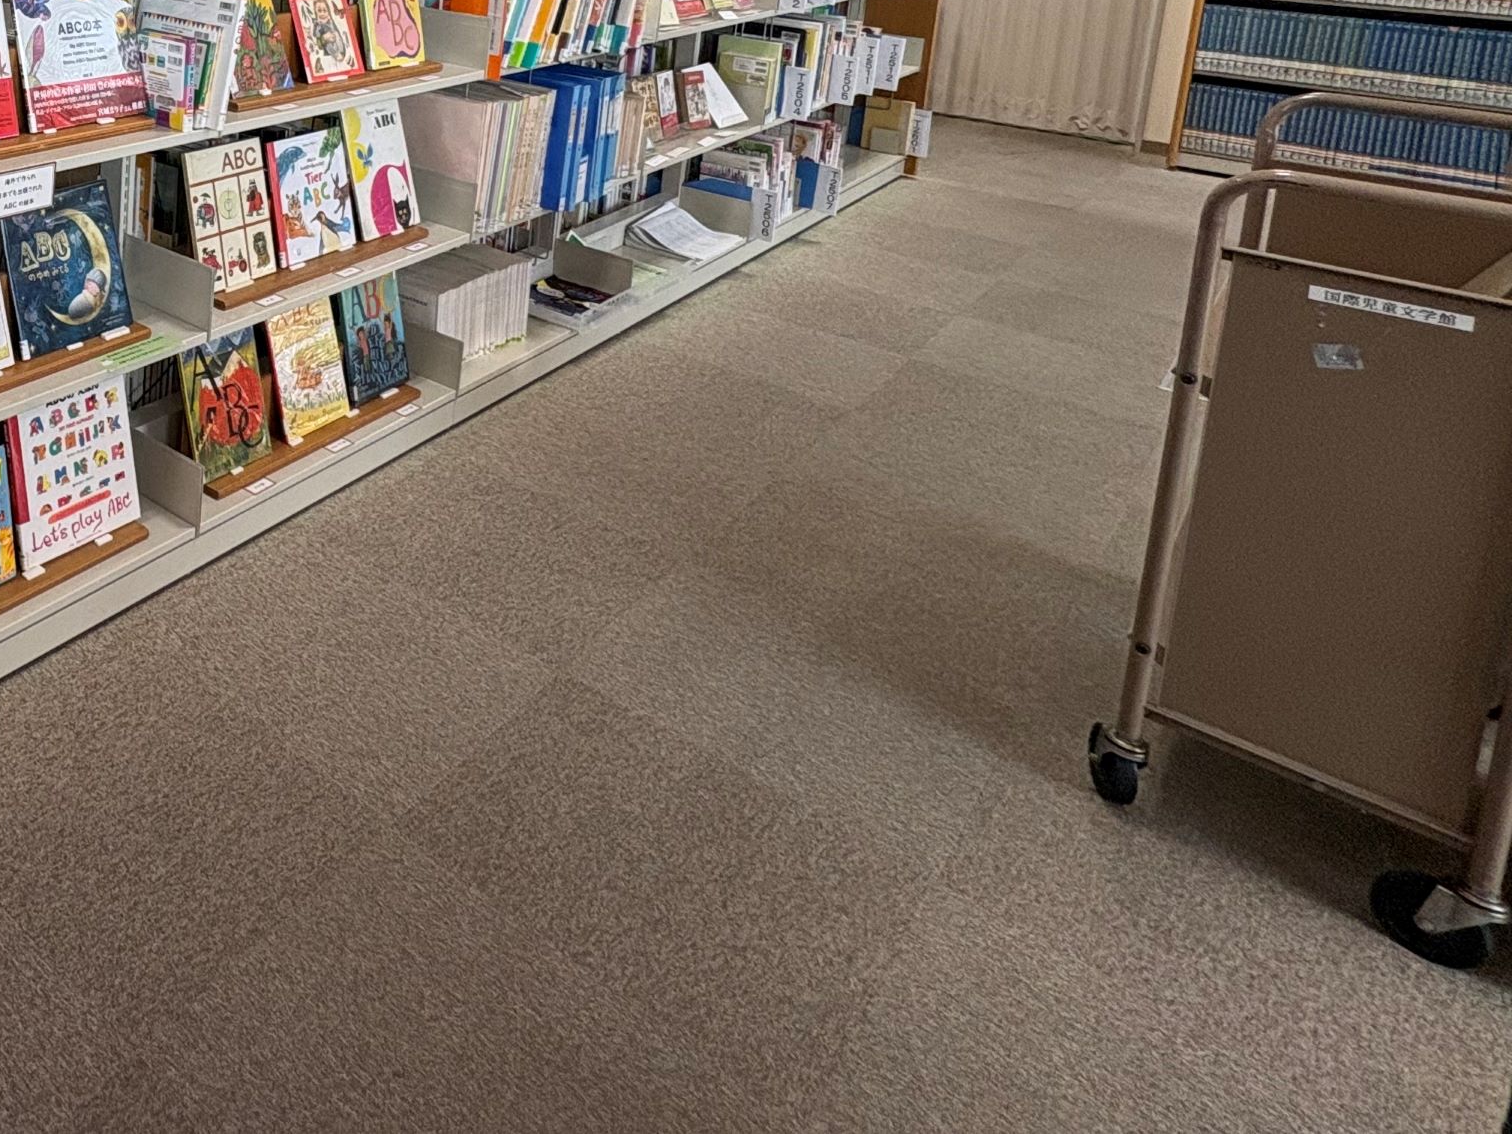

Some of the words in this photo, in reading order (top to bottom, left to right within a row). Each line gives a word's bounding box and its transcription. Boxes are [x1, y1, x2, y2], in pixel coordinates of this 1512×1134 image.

[58, 18, 103, 35] ABCの本
[793, 73, 805, 116] T2504
[373, 113, 397, 130] ABC
[221, 147, 257, 173] ABC
[304, 170, 323, 186] Tier
[303, 181, 330, 208] ABC
[19, 230, 71, 272] ABC
[31, 525, 68, 552] Let's
[71, 509, 103, 539] play
[108, 492, 132, 517] ABC
